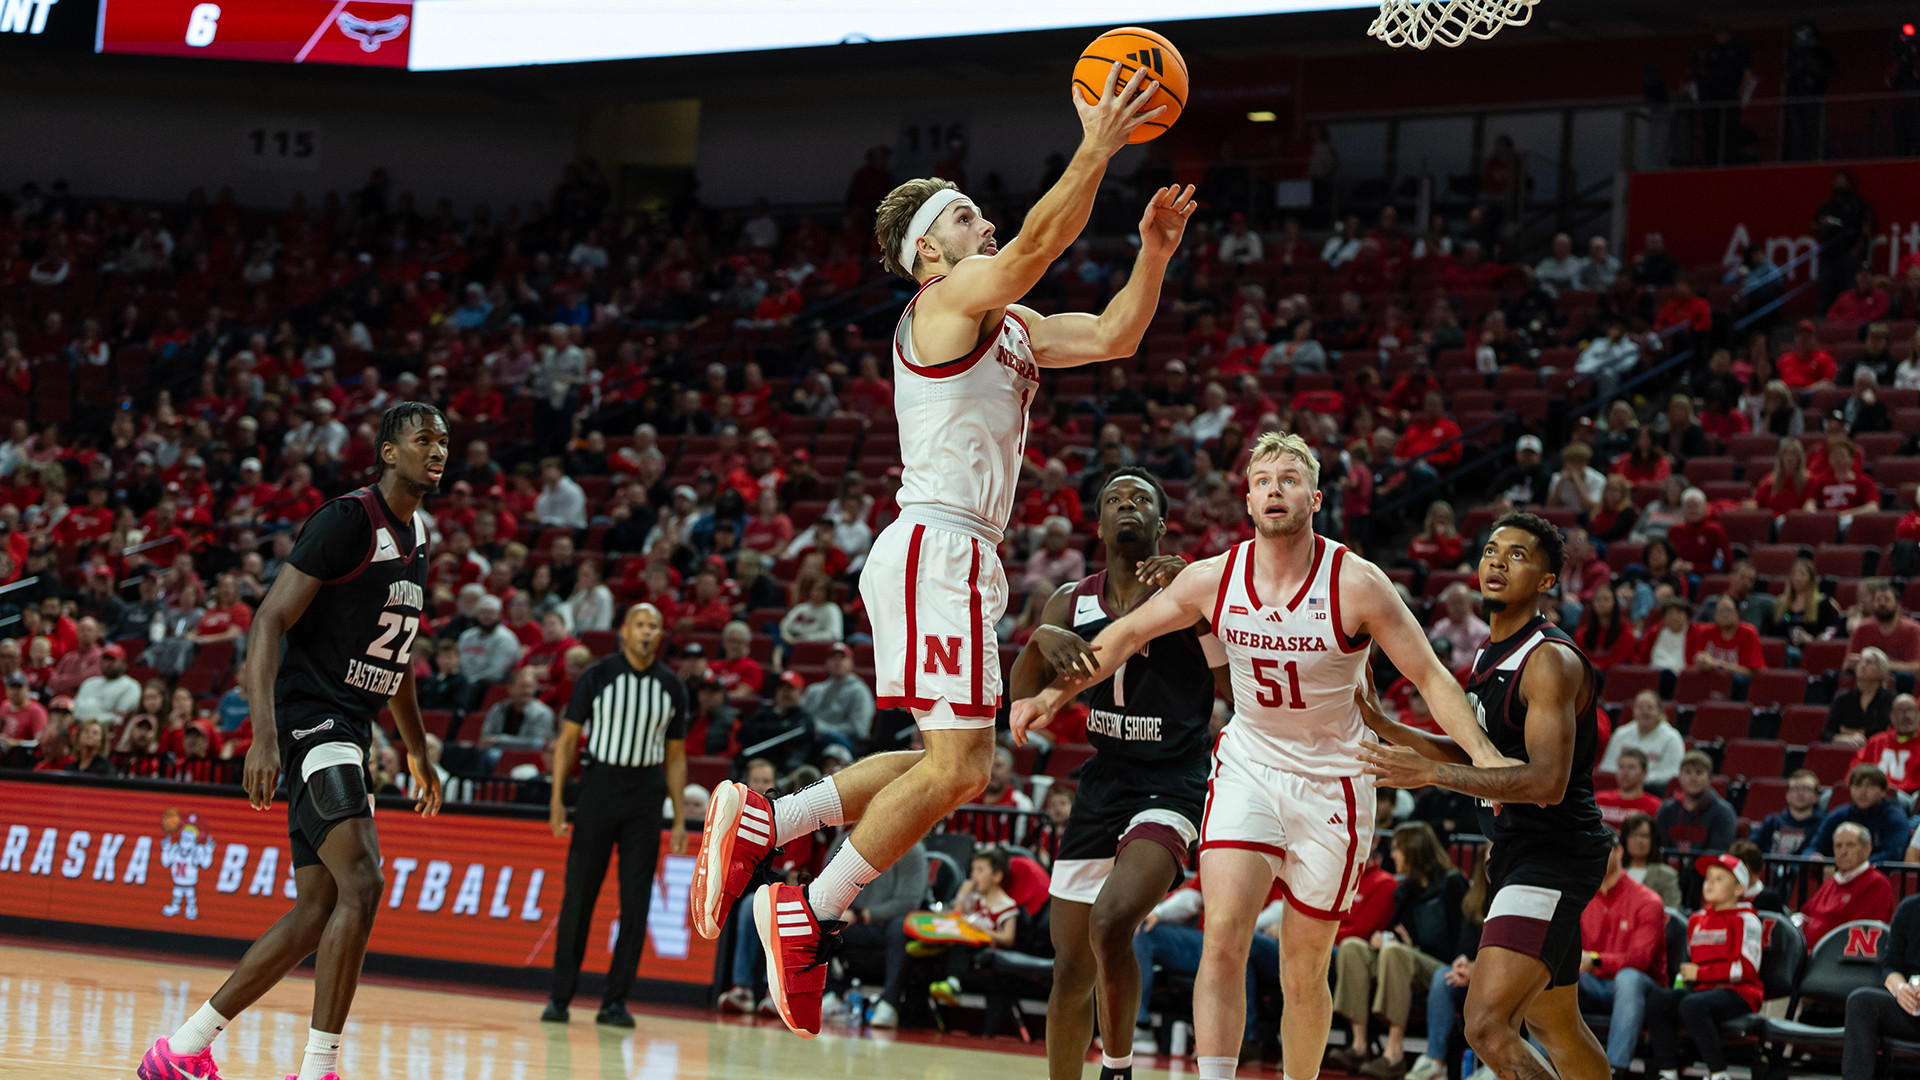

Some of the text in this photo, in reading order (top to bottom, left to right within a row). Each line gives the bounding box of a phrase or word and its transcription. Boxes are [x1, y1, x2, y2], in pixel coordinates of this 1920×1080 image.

[185, 3, 221, 47] 6
[249, 129, 315, 158] 115
[1722, 221, 1920, 282] Amrit
[366, 611, 420, 665] 22
[923, 634, 963, 677] N
[1225, 628, 1328, 652] NEBRASKA
[344, 658, 395, 695] EASTERN
[1251, 657, 1307, 709] 51
[1086, 708, 1162, 742] EASTERN SHORE
[216, 843, 545, 921] BASTBALL
[1843, 926, 1882, 958] N
